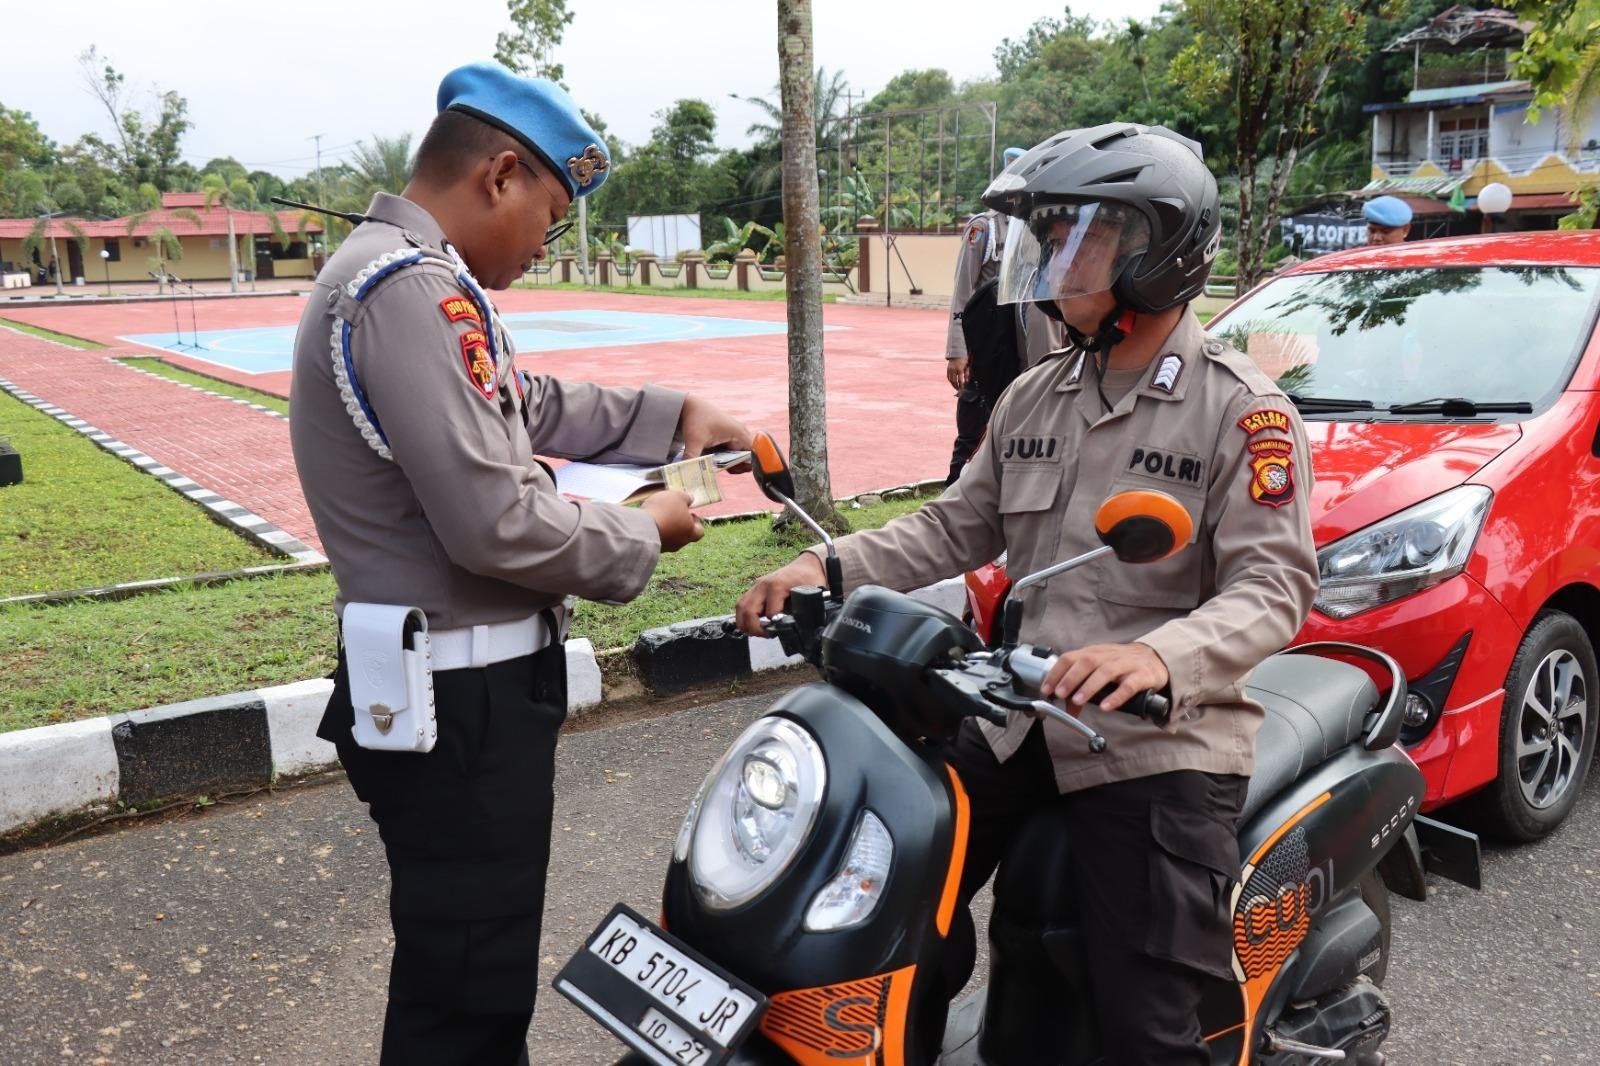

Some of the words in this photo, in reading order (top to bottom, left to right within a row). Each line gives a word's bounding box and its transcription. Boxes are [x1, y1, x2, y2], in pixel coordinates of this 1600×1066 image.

[446, 301, 463, 315] BID
[1004, 438, 1056, 459] JULI
[1129, 448, 1201, 482] POLRI
[599, 928, 638, 965] KB
[637, 951, 702, 1007] 5704
[699, 996, 740, 1033] JR
